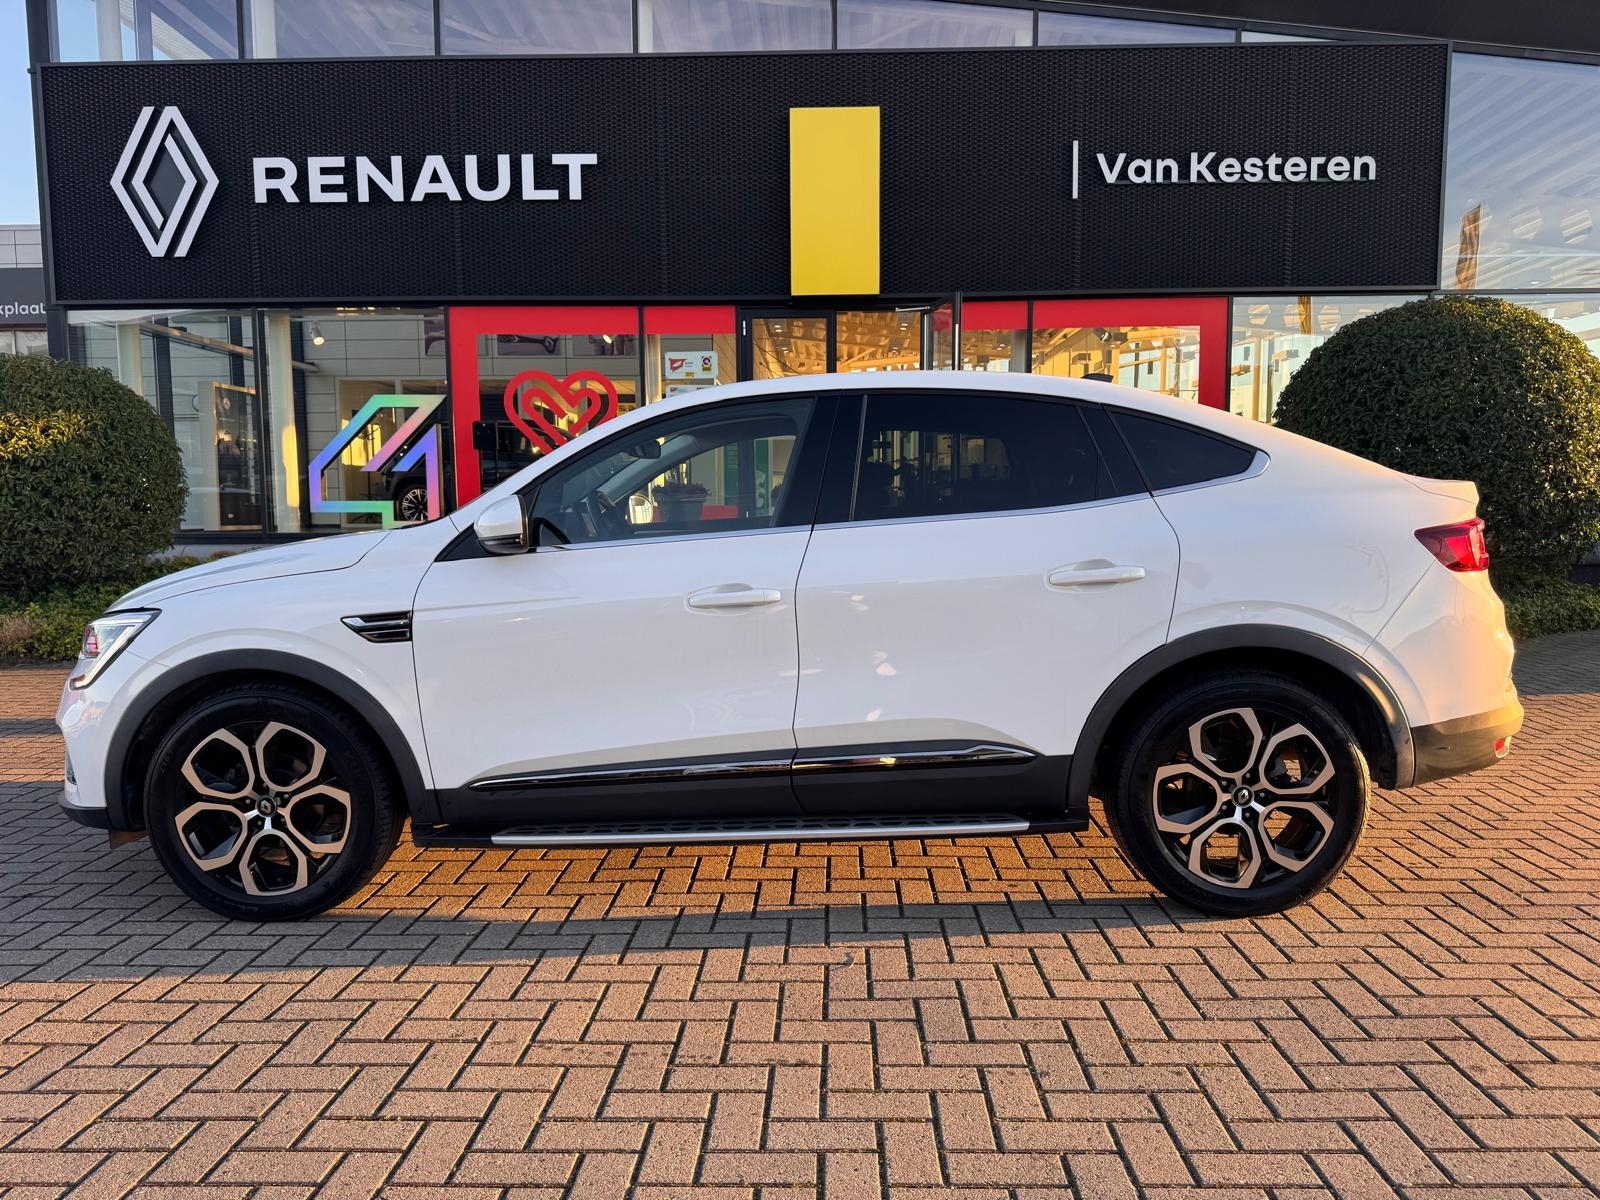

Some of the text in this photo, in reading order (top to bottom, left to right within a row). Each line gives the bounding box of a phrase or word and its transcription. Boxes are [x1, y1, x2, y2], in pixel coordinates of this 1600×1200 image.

[252, 153, 598, 204] RENAULT
[1096, 151, 1377, 184] Van Kesteren
